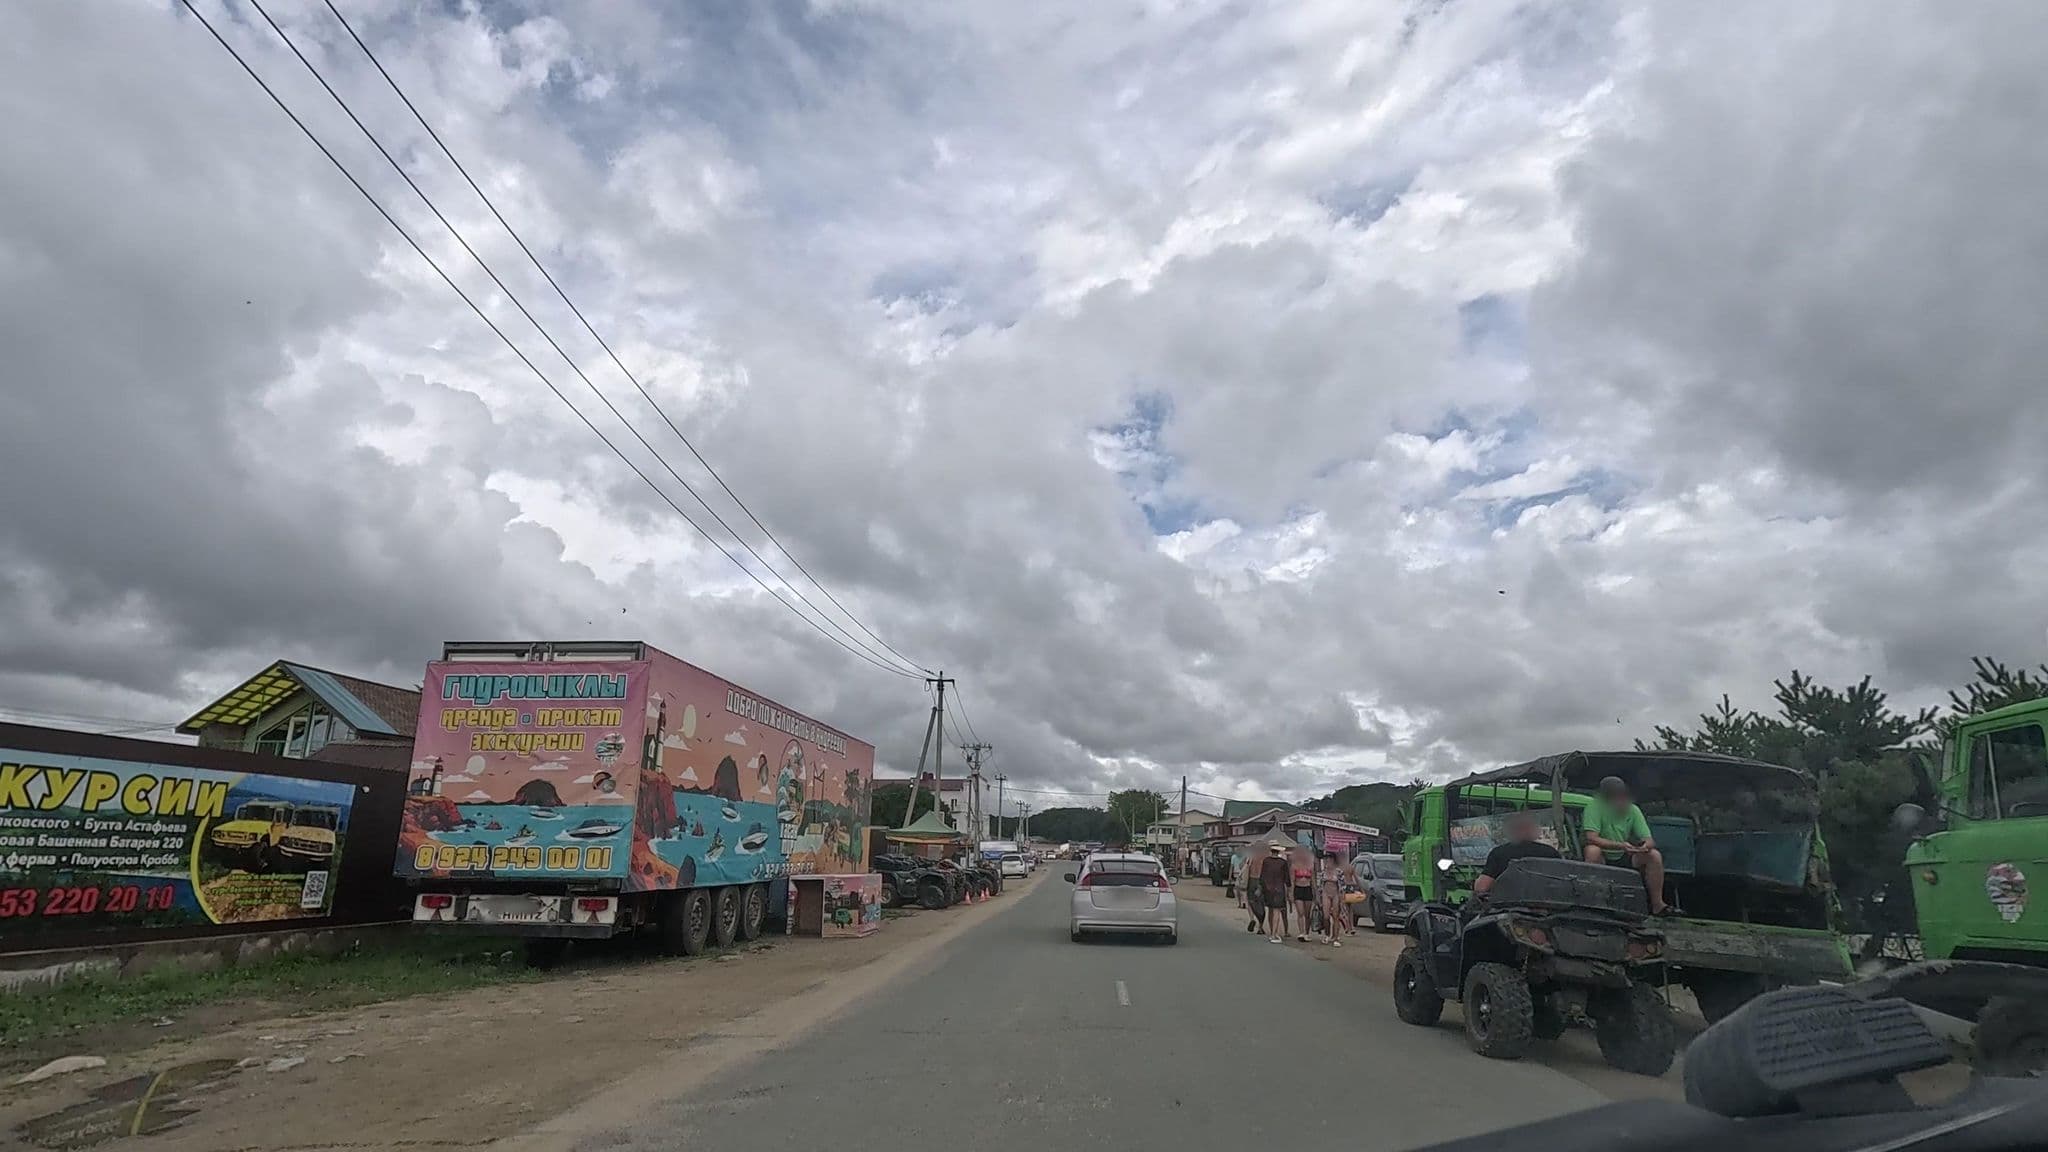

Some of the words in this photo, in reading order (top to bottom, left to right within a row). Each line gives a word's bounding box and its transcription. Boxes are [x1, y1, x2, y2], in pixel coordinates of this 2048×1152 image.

[726, 689, 757, 720] ДОБРО
[758, 702, 809, 740] ПОЖАЛОВАТЬ
[471, 733, 586, 756] ЭКСКУРСИИ
[84, 817, 122, 833] Бухта
[124, 819, 187, 835] Астафьева
[38, 834, 107, 848] Башенная
[109, 836, 160, 851] Батарея
[162, 837, 184, 849] 220
[6, 851, 57, 868] ферма
[414, 846, 436, 870] 8
[437, 846, 489, 870] 924
[489, 846, 544, 870] 249
[546, 846, 582, 871] 00
[584, 847, 612, 871] 01
[43, 887, 99, 916] 220
[104, 885, 140, 912] 20
